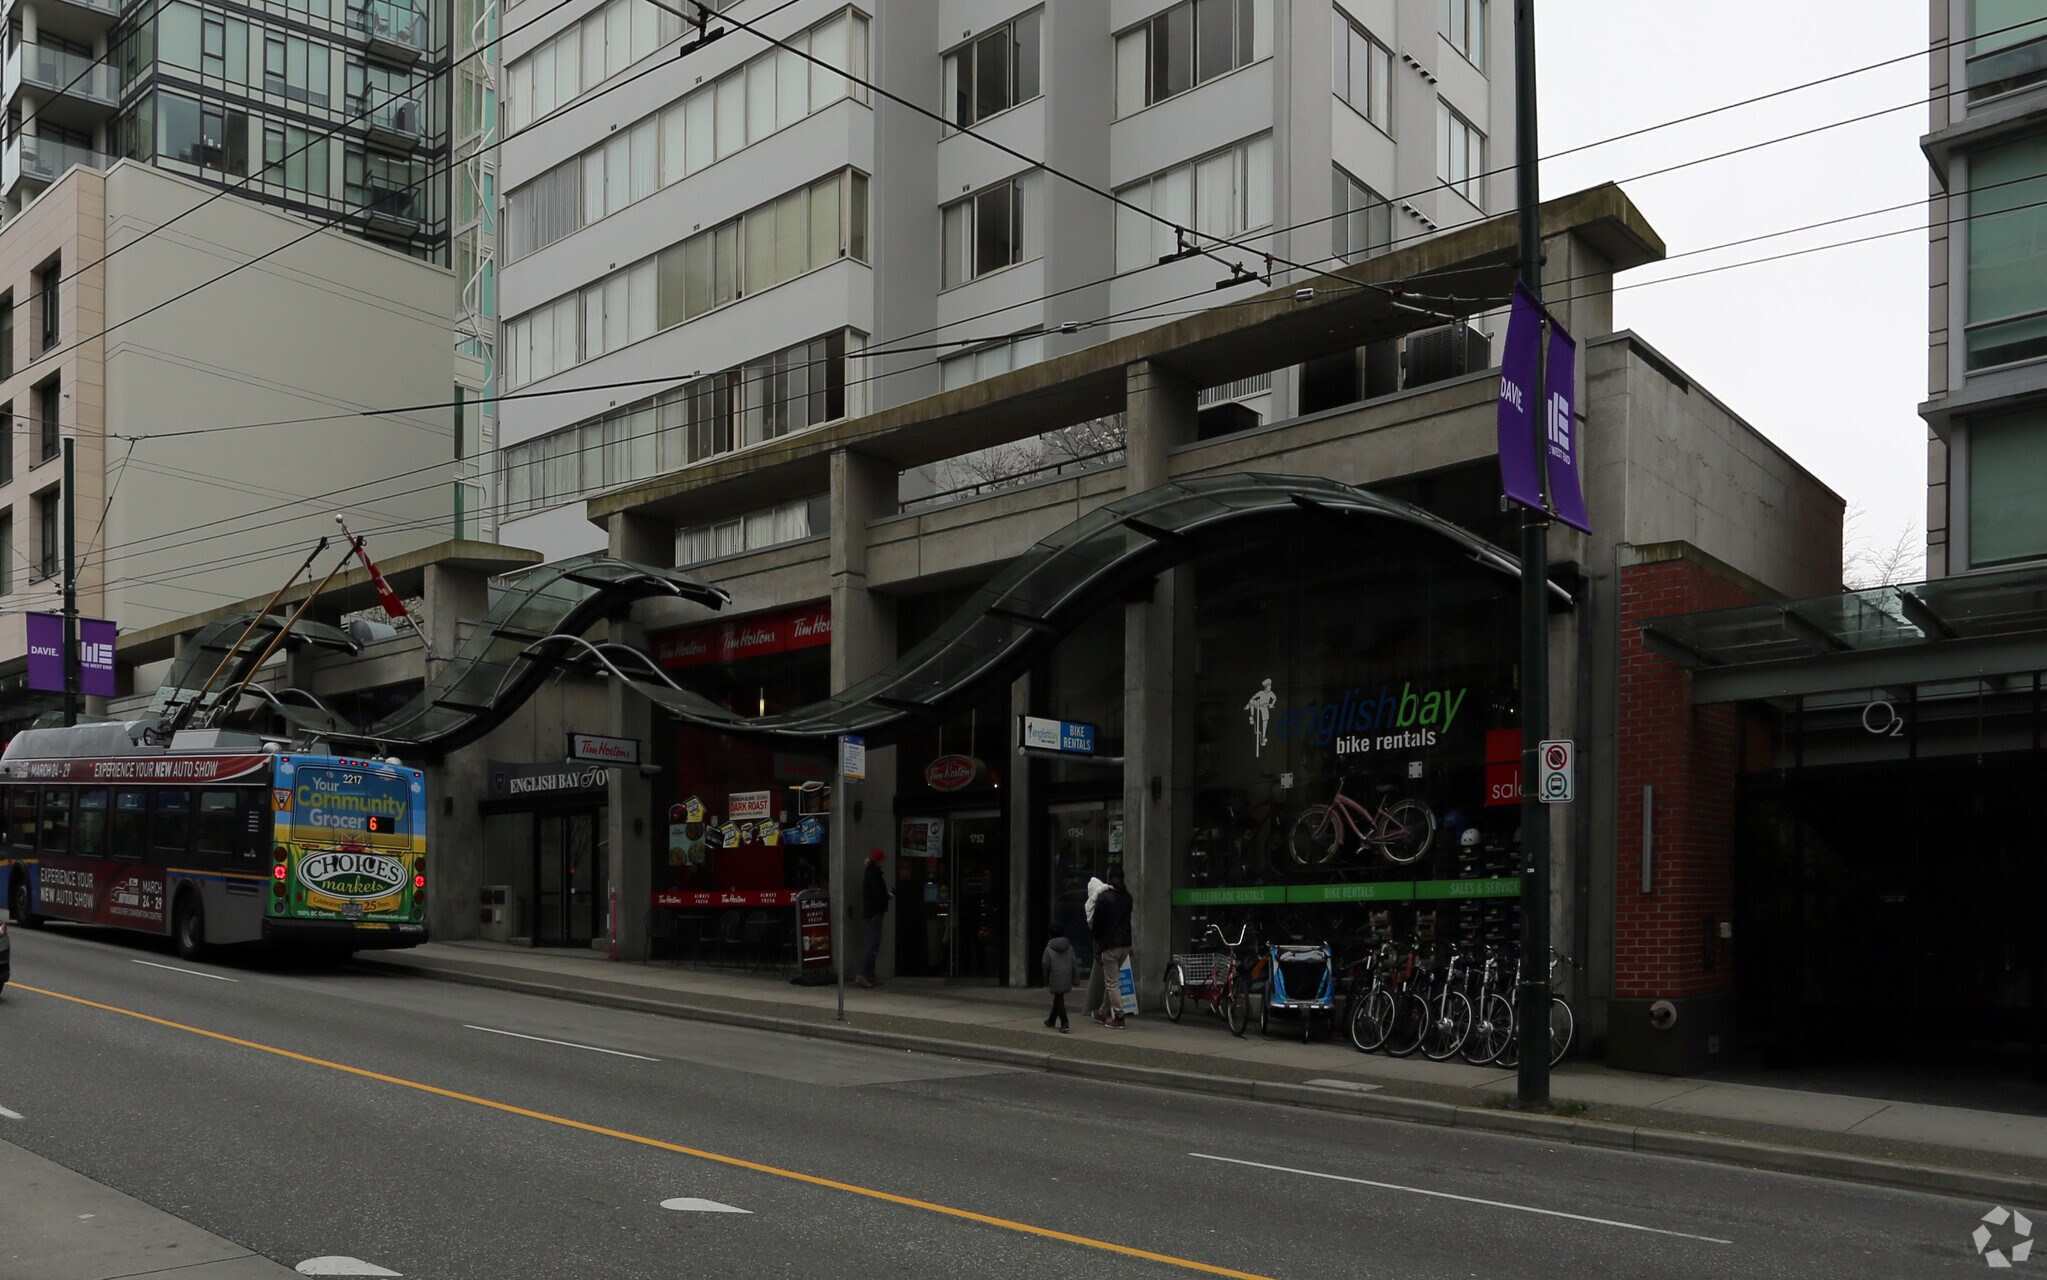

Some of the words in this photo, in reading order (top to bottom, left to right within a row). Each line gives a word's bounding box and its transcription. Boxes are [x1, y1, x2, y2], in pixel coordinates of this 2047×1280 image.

[793, 617, 812, 638] Tim
[722, 630, 739, 650] Tim
[740, 628, 775, 647] Hortons
[659, 642, 674, 660] Tim
[675, 639, 707, 657] Hortons
[1069, 724, 1085, 737] BIKE
[582, 740, 598, 755] Tim
[598, 741, 630, 758] Hortons
[1063, 737, 1091, 751] RENTALS
[1336, 736, 1370, 755] bike
[1376, 728, 1437, 751] rentals
[31, 763, 51, 778] MARCH
[94, 762, 134, 778] EXPERIENCE
[135, 762, 153, 777] YOUR
[154, 762, 172, 777] NEW
[172, 762, 193, 777] AUTO
[194, 761, 218, 777] SHOW
[930, 767, 944, 780] Tim
[944, 764, 974, 779] Hortons
[312, 777, 340, 792] Your
[343, 774, 363, 785] 2217
[510, 774, 557, 794] ENGLISH
[559, 772, 580, 789] BAY
[297, 785, 407, 821] Community
[730, 801, 747, 812] DARK
[747, 800, 768, 811] ROAST
[309, 808, 365, 829] Grocer
[369, 816, 378, 831] 6
[970, 833, 985, 843] 1752
[306, 854, 399, 882] CHOICES
[40, 867, 77, 886] EXPERIENCE
[77, 872, 94, 888] YOUR
[321, 875, 385, 893] markets
[142, 880, 163, 895] MARCH
[1324, 887, 1341, 899] BIKE
[1342, 886, 1375, 898] RENTALS
[1450, 883, 1475, 895] SALES
[1477, 883, 1483, 894] &
[1485, 881, 1520, 894] SERVICE
[40, 887, 55, 902] NEW
[56, 888, 73, 906] AUTO
[74, 891, 94, 909] SHOW
[142, 895, 150, 908] 24
[155, 896, 163, 910] 29
[658, 894, 667, 904] Tim
[666, 894, 681, 904] Hortons
[721, 893, 730, 904] Tim
[729, 893, 746, 903] Hortons
[1191, 891, 1234, 902] ROLLERBLADE
[1236, 890, 1265, 901] RENTALS
[363, 901, 377, 911] 25
[801, 900, 810, 909] Tim
[810, 899, 828, 909] Hortons
